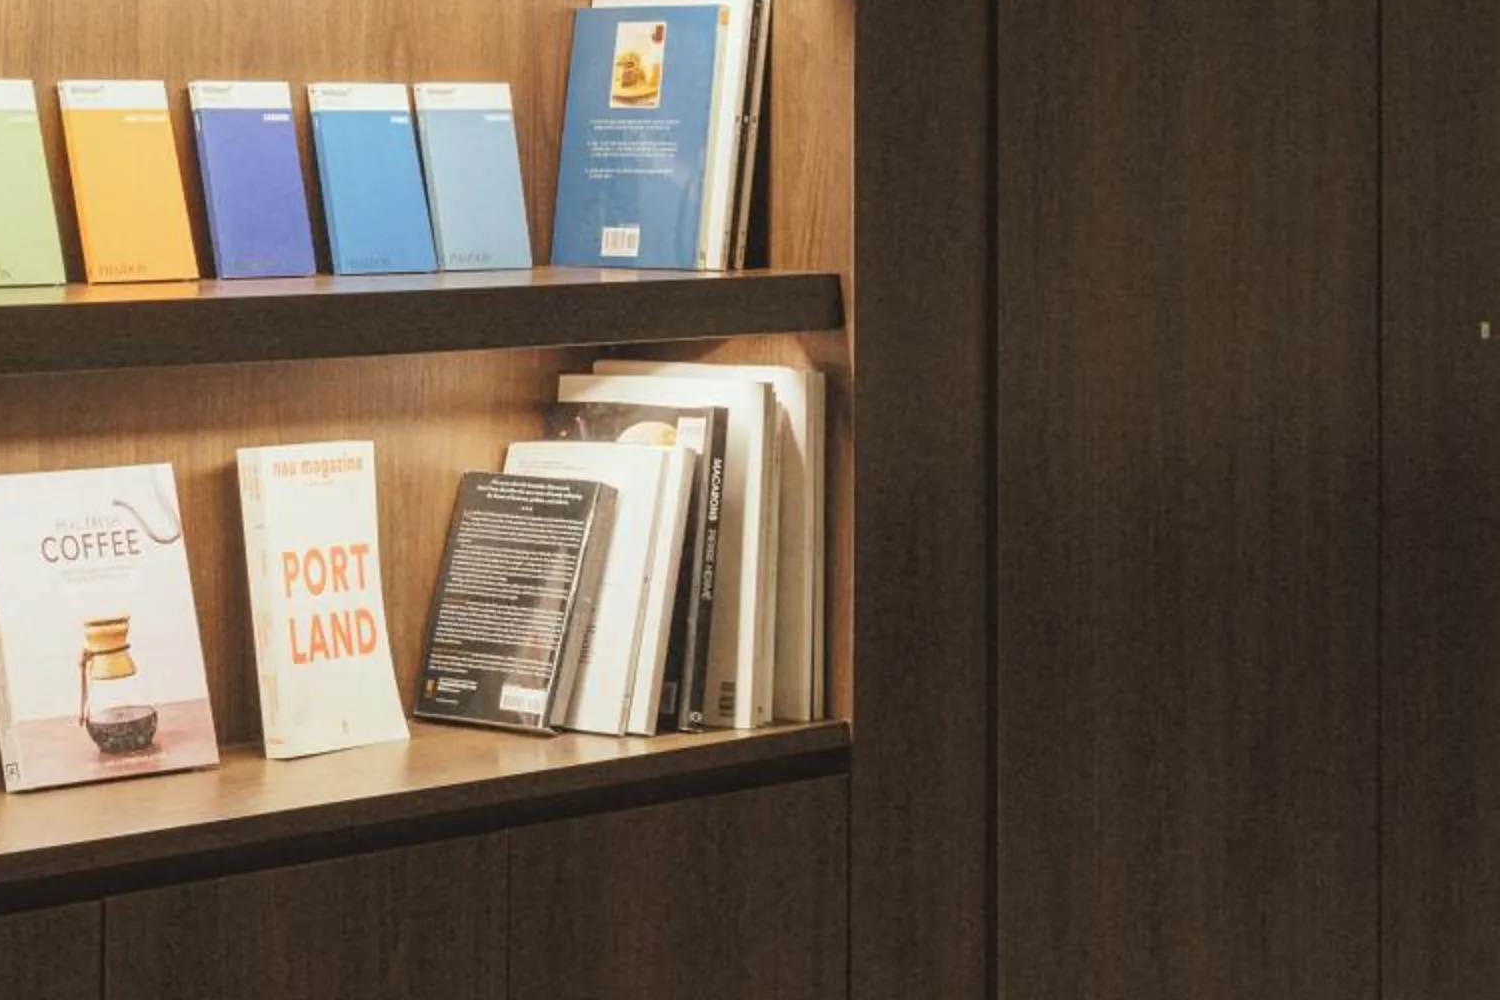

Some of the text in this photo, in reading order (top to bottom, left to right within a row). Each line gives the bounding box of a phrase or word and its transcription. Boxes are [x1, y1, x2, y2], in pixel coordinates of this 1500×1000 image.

[301, 451, 364, 479] magazine
[41, 528, 142, 563] COFFEE
[282, 544, 370, 599] PORT
[289, 608, 378, 666] LAND
